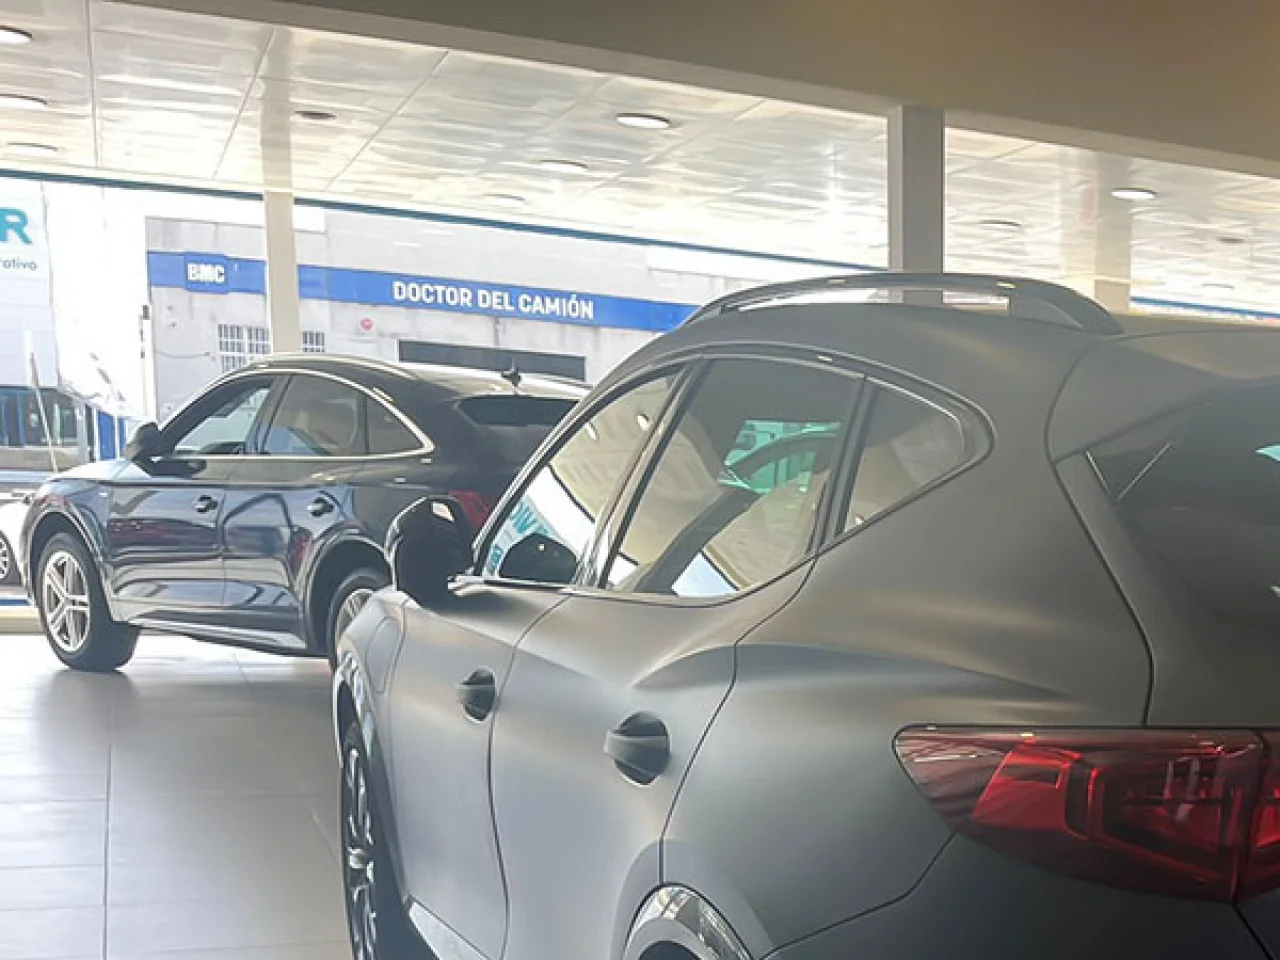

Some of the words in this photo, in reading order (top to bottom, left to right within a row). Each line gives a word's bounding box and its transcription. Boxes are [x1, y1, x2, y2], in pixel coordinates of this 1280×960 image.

[187, 262, 225, 284] BMC
[392, 281, 472, 307] DOCTOR
[477, 289, 515, 310] DEL
[518, 293, 594, 320] CAMIÓN
